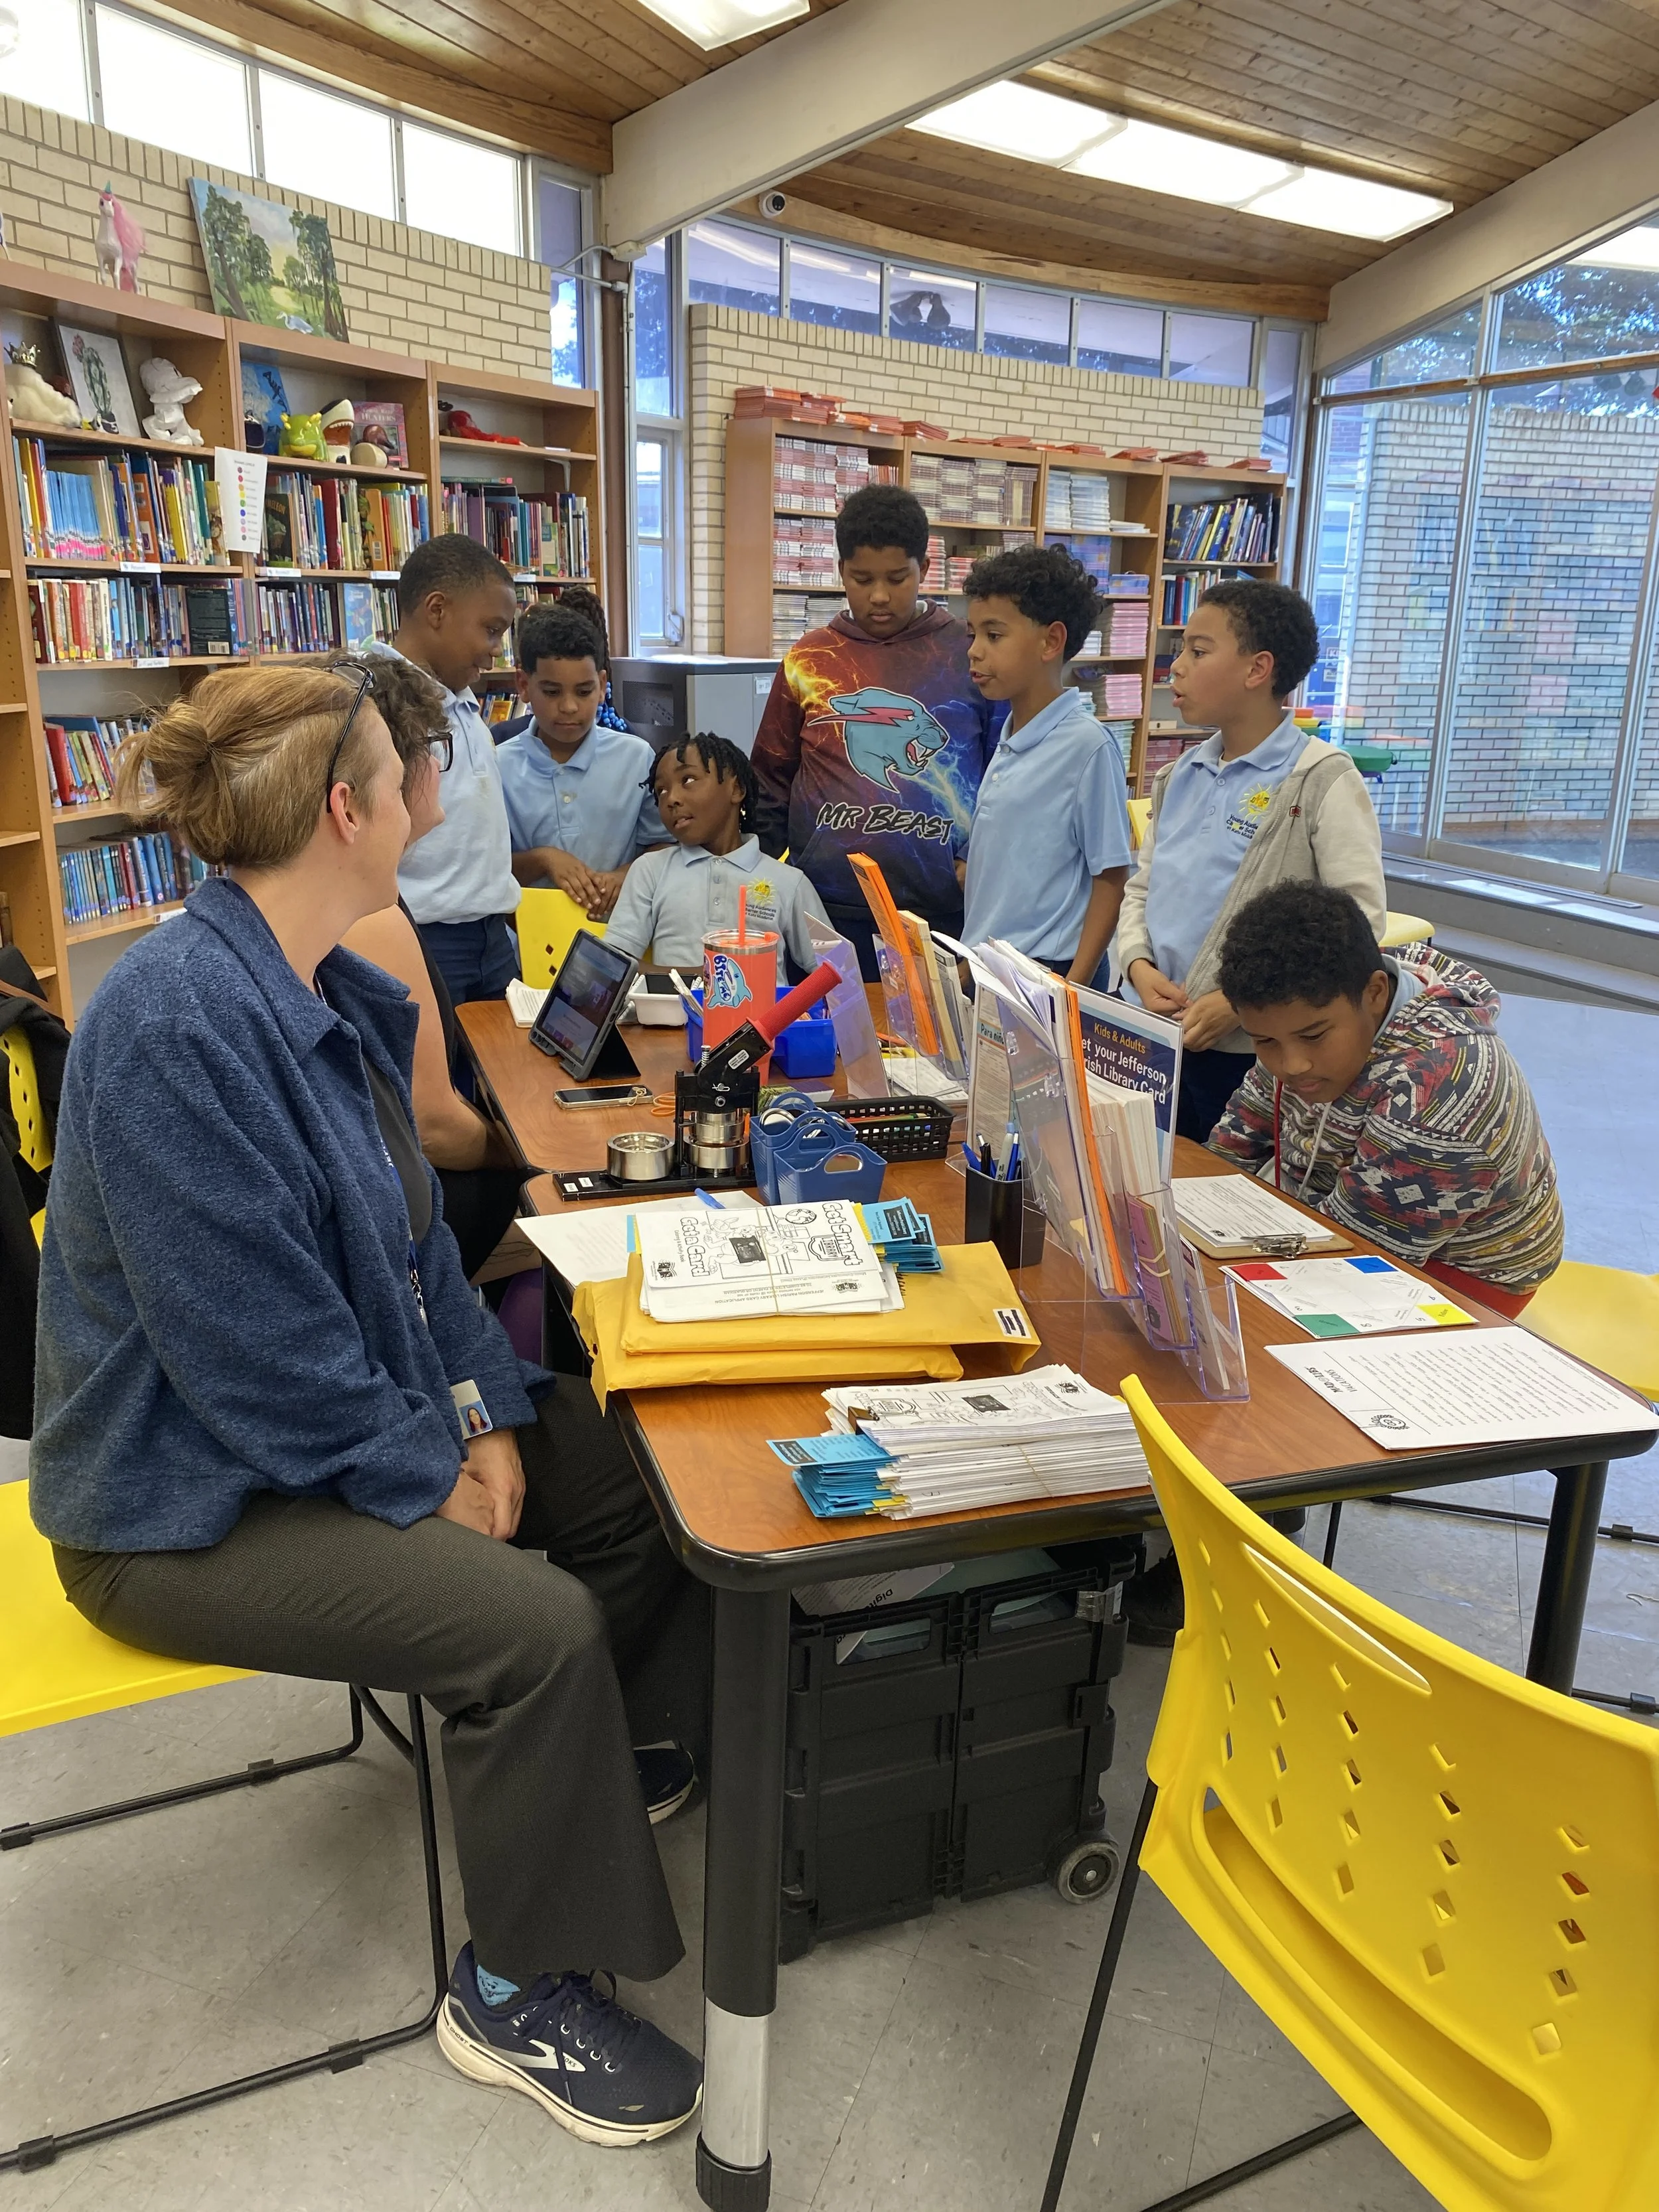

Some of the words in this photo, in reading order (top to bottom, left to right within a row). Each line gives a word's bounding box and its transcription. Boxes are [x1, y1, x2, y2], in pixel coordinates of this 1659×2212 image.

[816, 802, 865, 830] MR
[863, 804, 954, 846] BEAST
[1229, 814, 1244, 824] Young
[755, 905, 776, 913] Audiences
[714, 955, 727, 983] BITE
[981, 1023, 993, 1039] Para
[1094, 1022, 1111, 1039] Kids
[1112, 1031, 1118, 1043] &
[1119, 1034, 1146, 1054] Adults
[1082, 1038, 1092, 1052] et
[1094, 1043, 1118, 1063] your
[1118, 1051, 1167, 1084] Jefferson
[1084, 1056, 1102, 1074] rish
[1103, 1063, 1139, 1091] Library
[1140, 1082, 1167, 1104] Card
[822, 1202, 847, 1224] Get
[680, 1217, 700, 1236] Get
[685, 1236, 699, 1245] a
[831, 1224, 863, 1266] Smart
[687, 1245, 711, 1278] Card
[1304, 1366, 1325, 1378] LIBS
[1325, 1369, 1358, 1392] VACATIONS
[1324, 1382, 1343, 1393] MAD
[868, 1588, 894, 1609] Digit
[449, 2026, 469, 2044] GHOST
